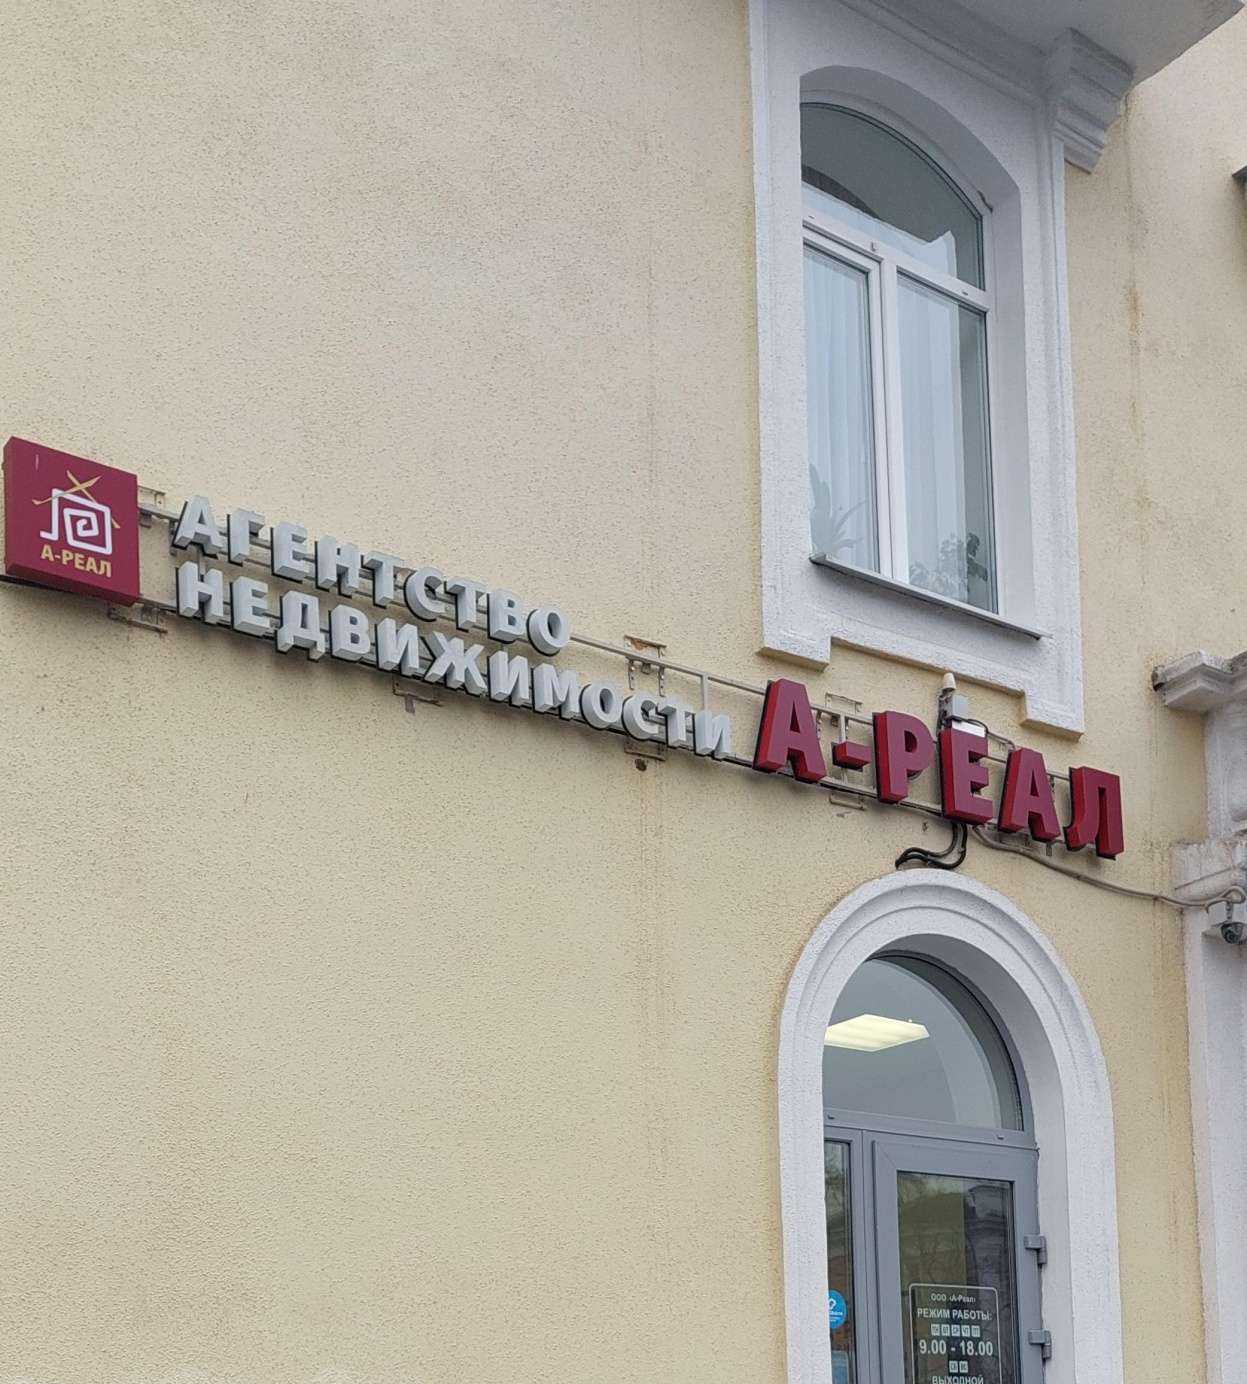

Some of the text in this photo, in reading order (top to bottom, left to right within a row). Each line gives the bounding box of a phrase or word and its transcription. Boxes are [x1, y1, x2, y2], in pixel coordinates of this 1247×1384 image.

[41, 543, 112, 577] А-РЕАЛ
[173, 495, 571, 656] АГЕНТСТВО
[176, 562, 732, 761] НЕДВИЖИМОСТИ
[753, 678, 1123, 860] А-РЕАЛ
[917, 1308, 993, 1320] РЕЖИМ РАБОТЫ:
[931, 1293, 946, 1301] ООО
[919, 1341, 947, 1354] 9.00
[960, 1340, 993, 1356] 18.00
